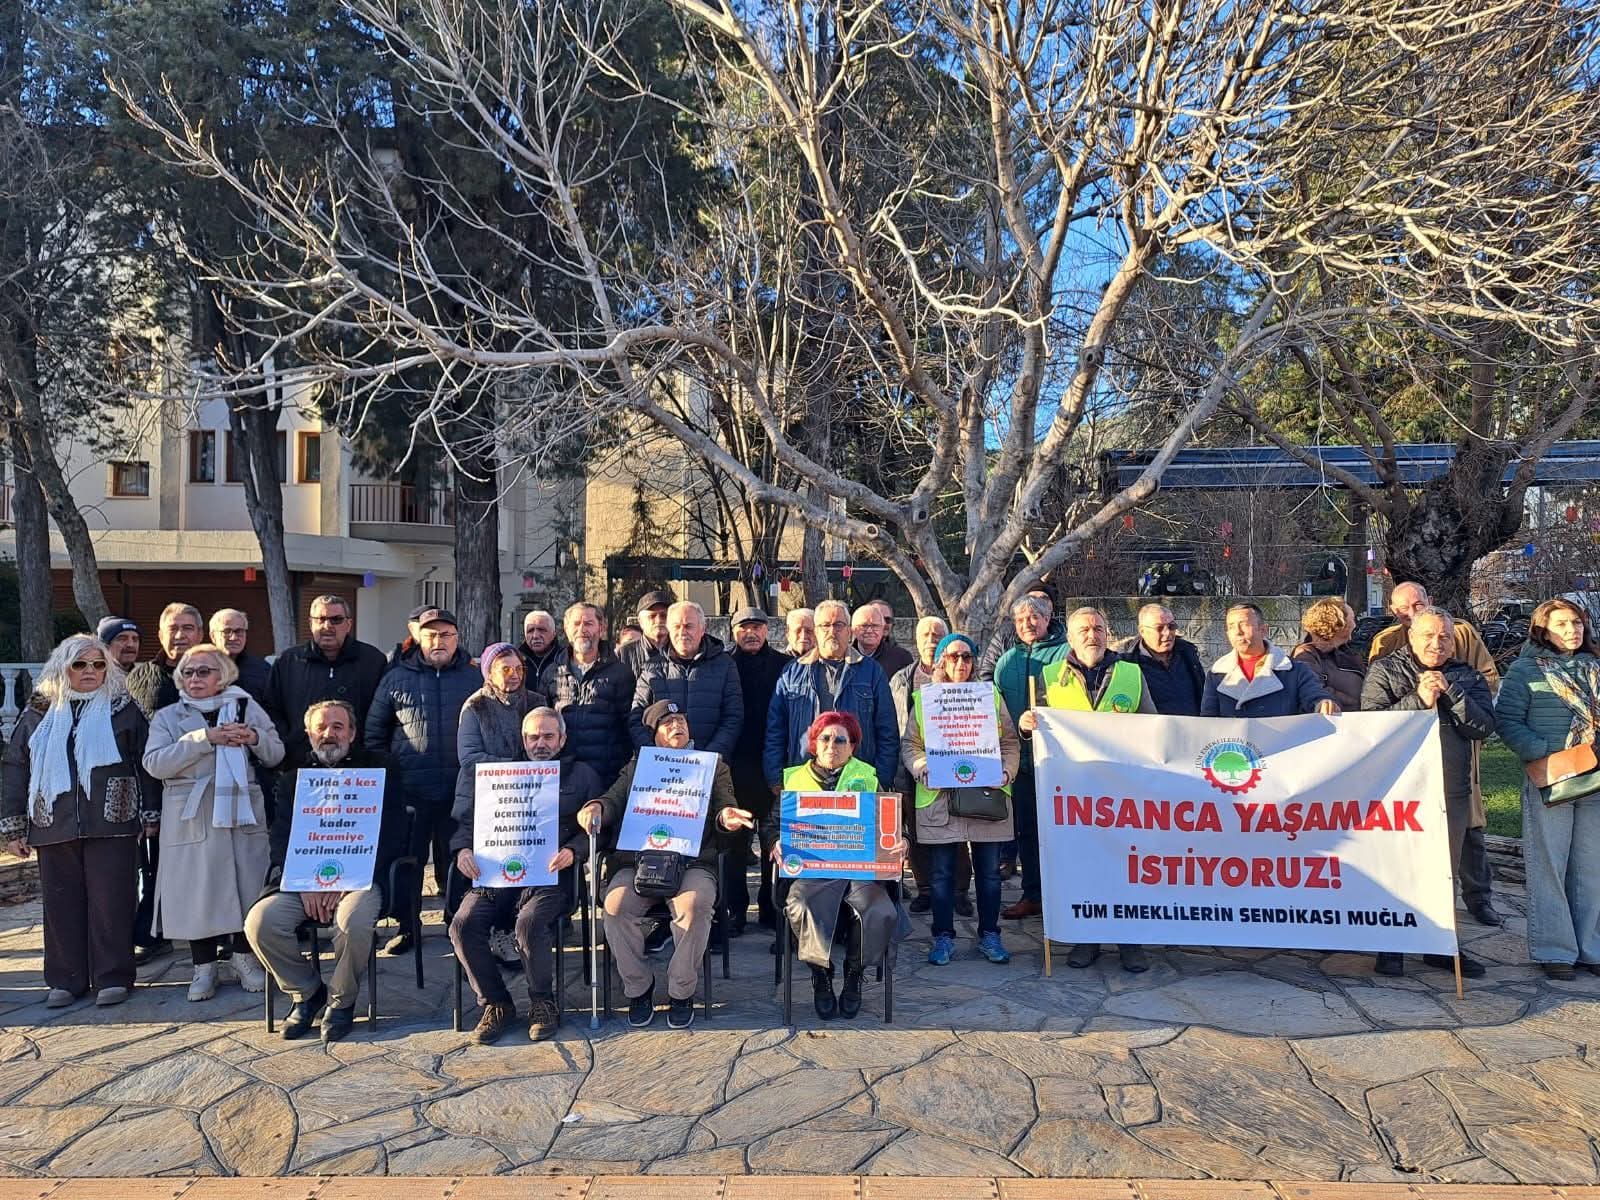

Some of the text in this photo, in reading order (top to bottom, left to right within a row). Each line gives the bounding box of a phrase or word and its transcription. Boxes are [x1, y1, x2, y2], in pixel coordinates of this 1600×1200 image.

[654, 754, 700, 765] Yoksulluk
[308, 776, 376, 787] Yılda 4 kez
[632, 784, 663, 792] kader
[324, 792, 358, 800] en az
[498, 796, 534, 804] SEFALET
[302, 804, 342, 816] asgari
[1053, 786, 1424, 841] İNSANCA YAŞAMAK
[319, 818, 357, 828] kadar
[308, 832, 365, 843] ikramiye
[294, 844, 374, 855] verilmelidir!
[1128, 845, 1342, 890] İSTİYORUZ!
[1072, 900, 1418, 928] TÜM EMEKLİLERİN SENDİKASI MUĞLA
